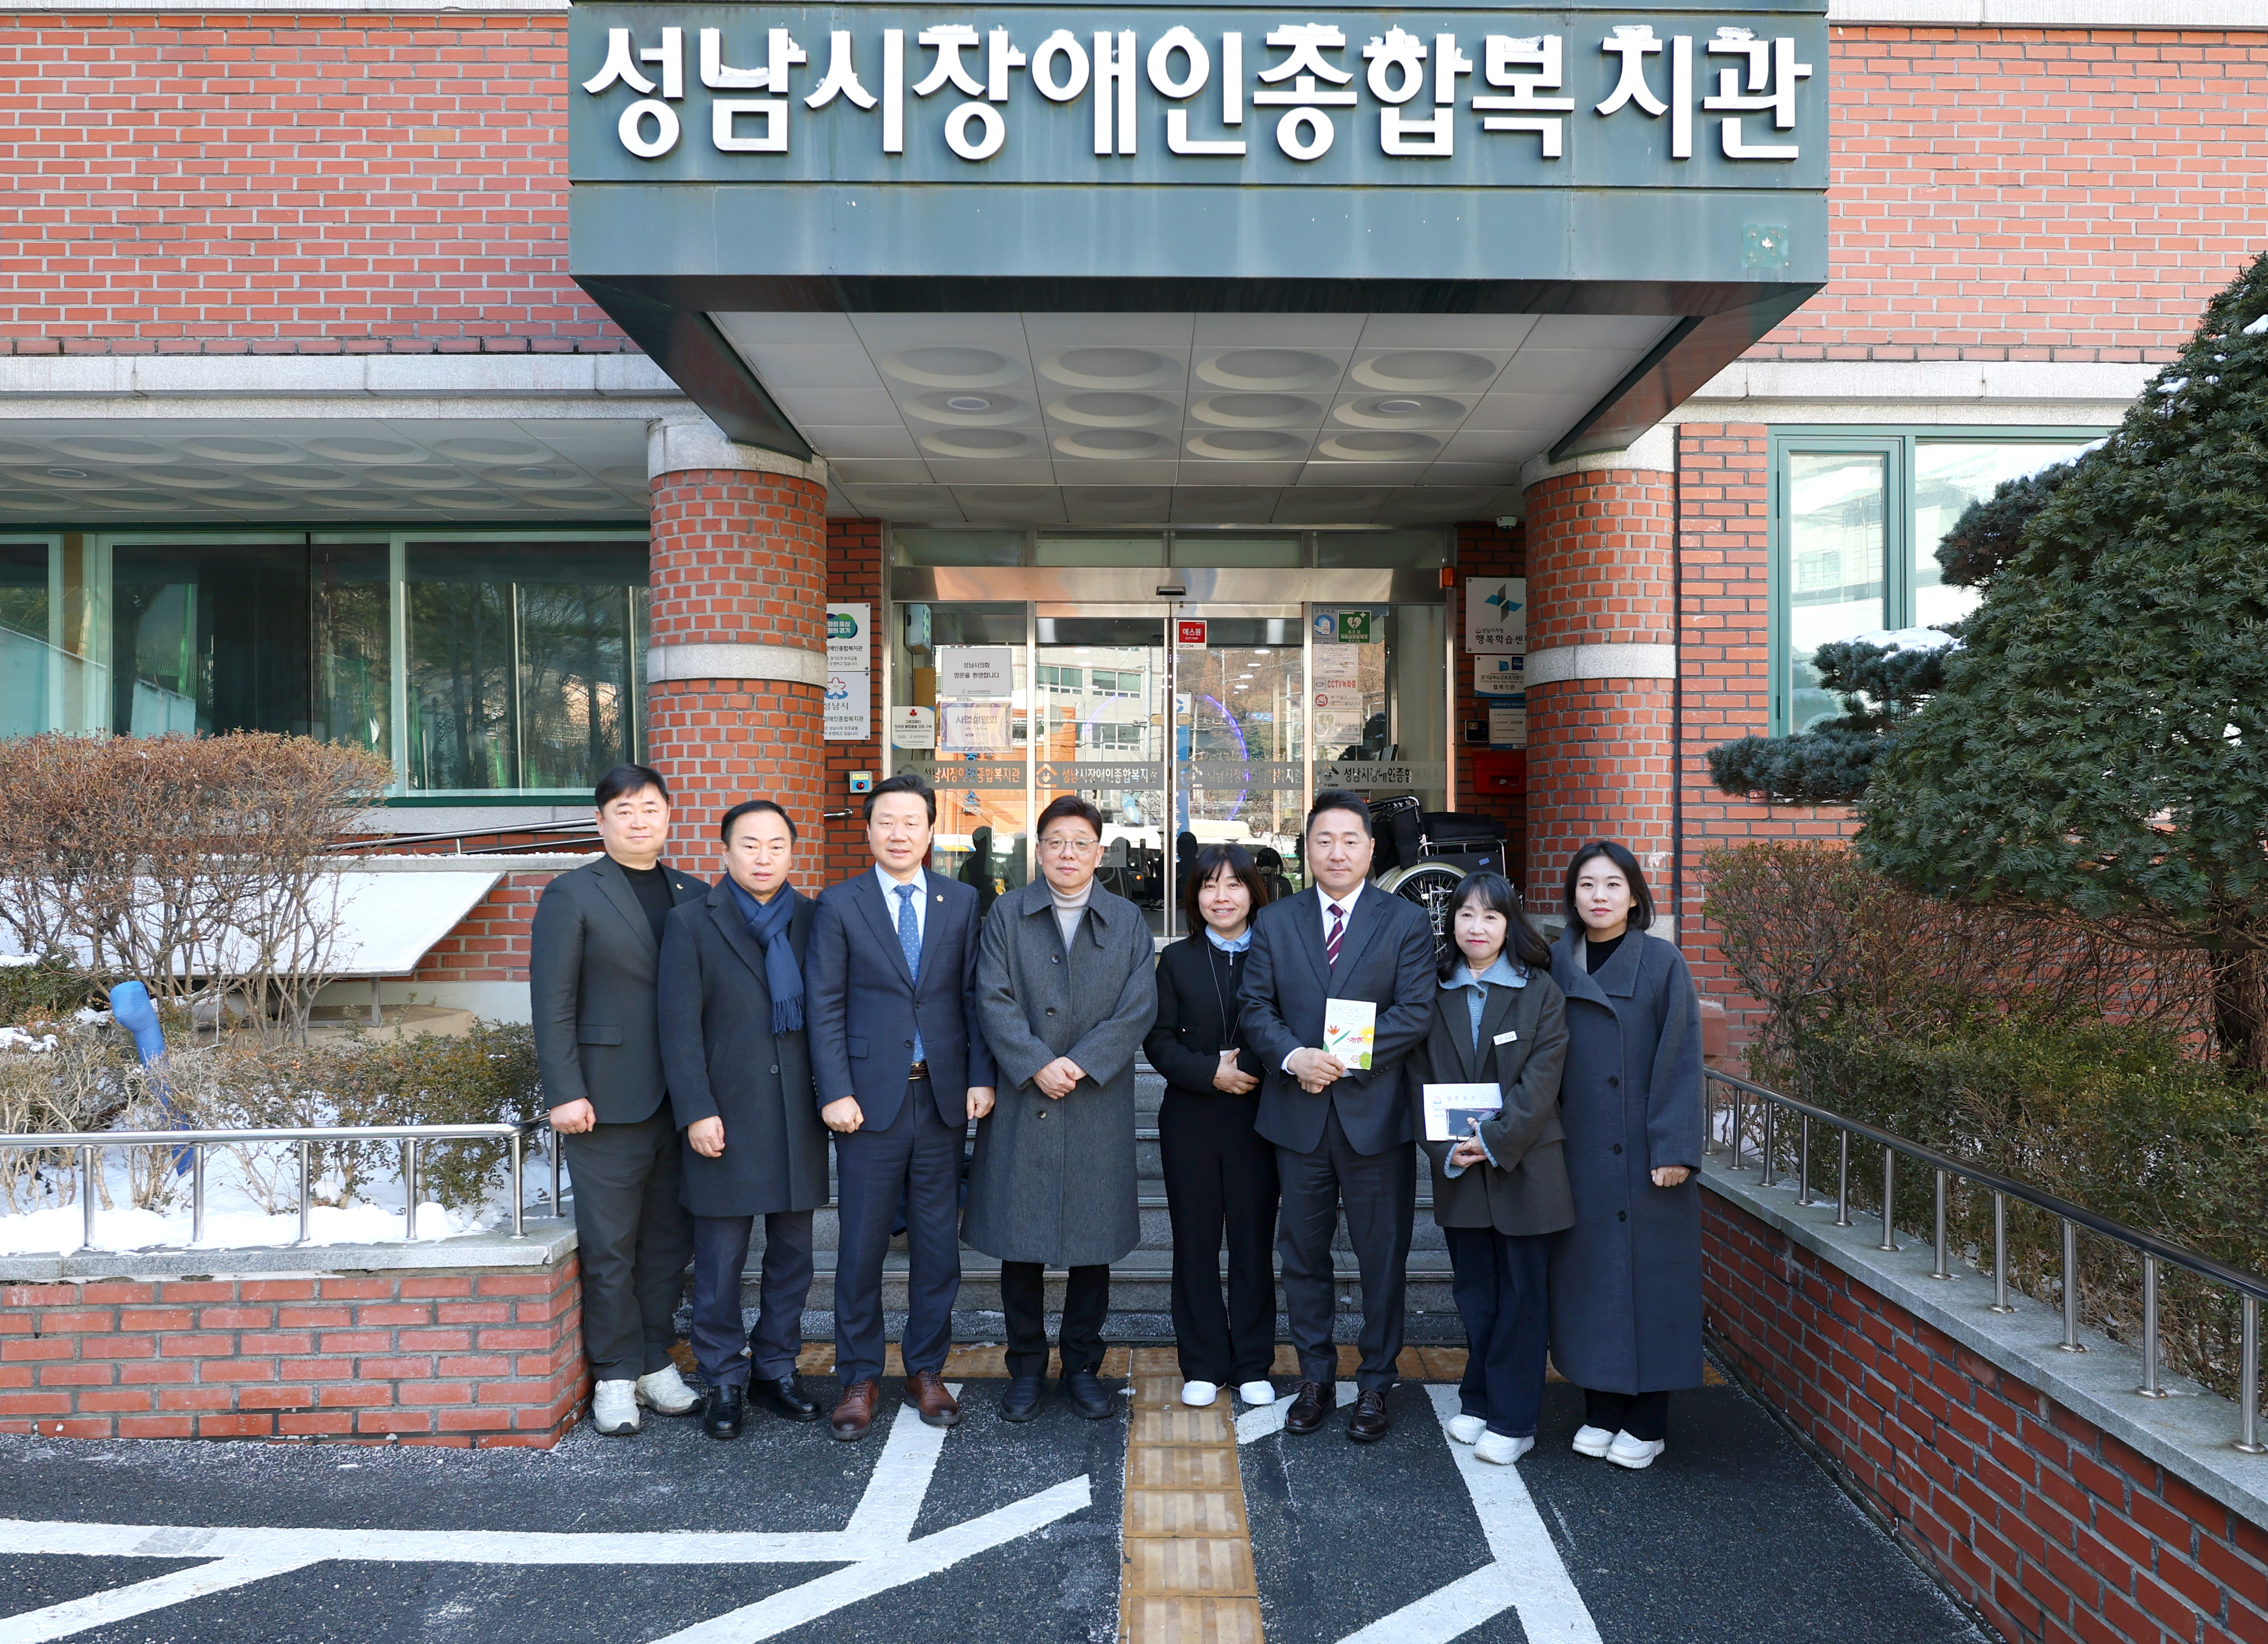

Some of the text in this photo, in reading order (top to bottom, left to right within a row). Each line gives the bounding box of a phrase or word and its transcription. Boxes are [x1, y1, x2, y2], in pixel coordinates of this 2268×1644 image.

[582, 24, 1814, 161] 성남시장애인종합복지관
[1476, 635, 1526, 644] 행복학습센
[824, 702, 848, 711] 성남시
[955, 715, 997, 724] 사업설명회
